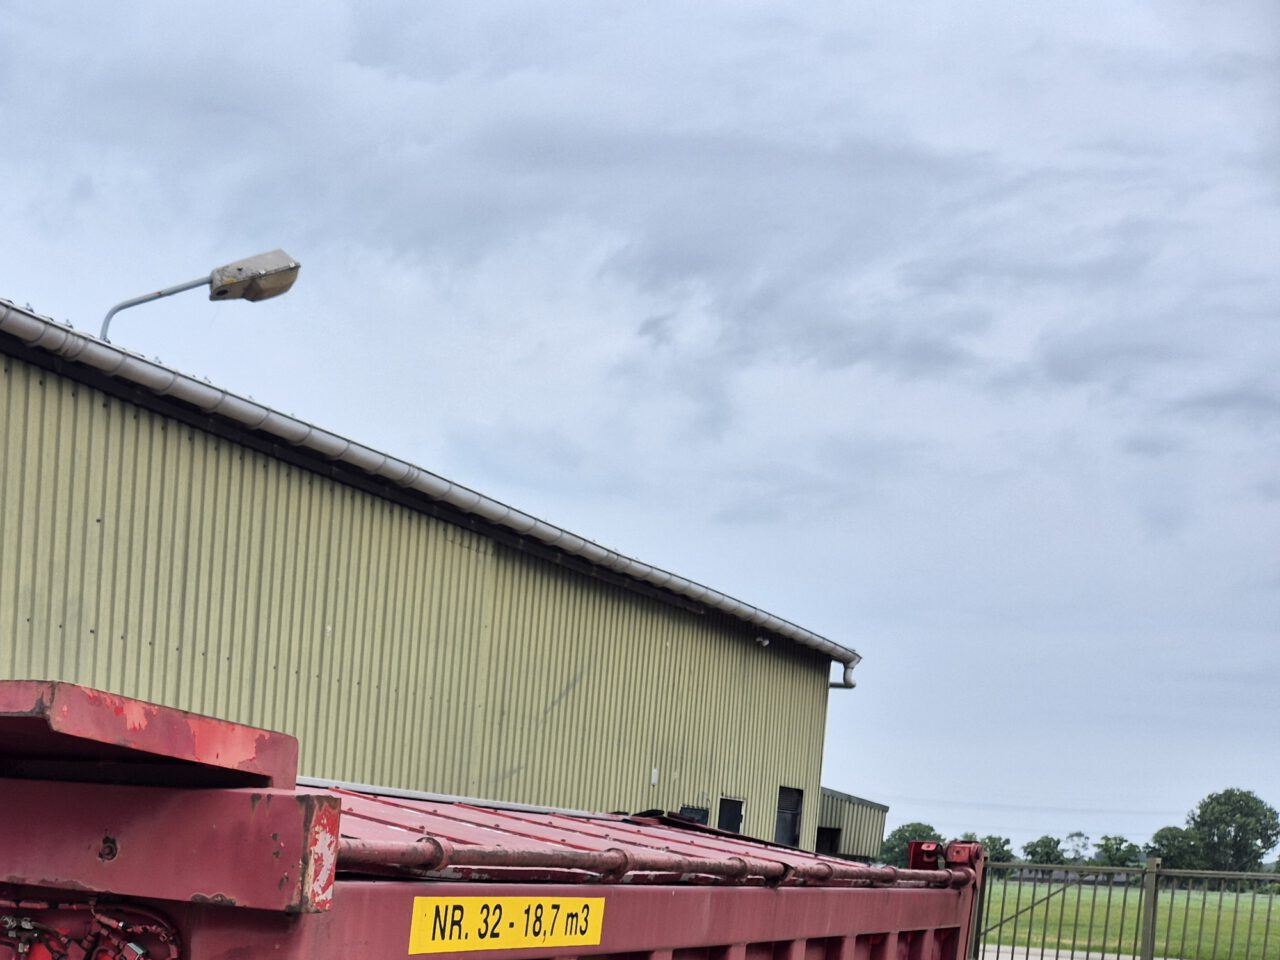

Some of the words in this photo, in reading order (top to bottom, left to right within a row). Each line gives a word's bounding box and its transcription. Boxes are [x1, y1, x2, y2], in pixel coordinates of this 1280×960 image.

[431, 904, 469, 941] NR.
[478, 903, 503, 938] 32
[524, 903, 560, 942] 18,7
[564, 904, 590, 936] m3
